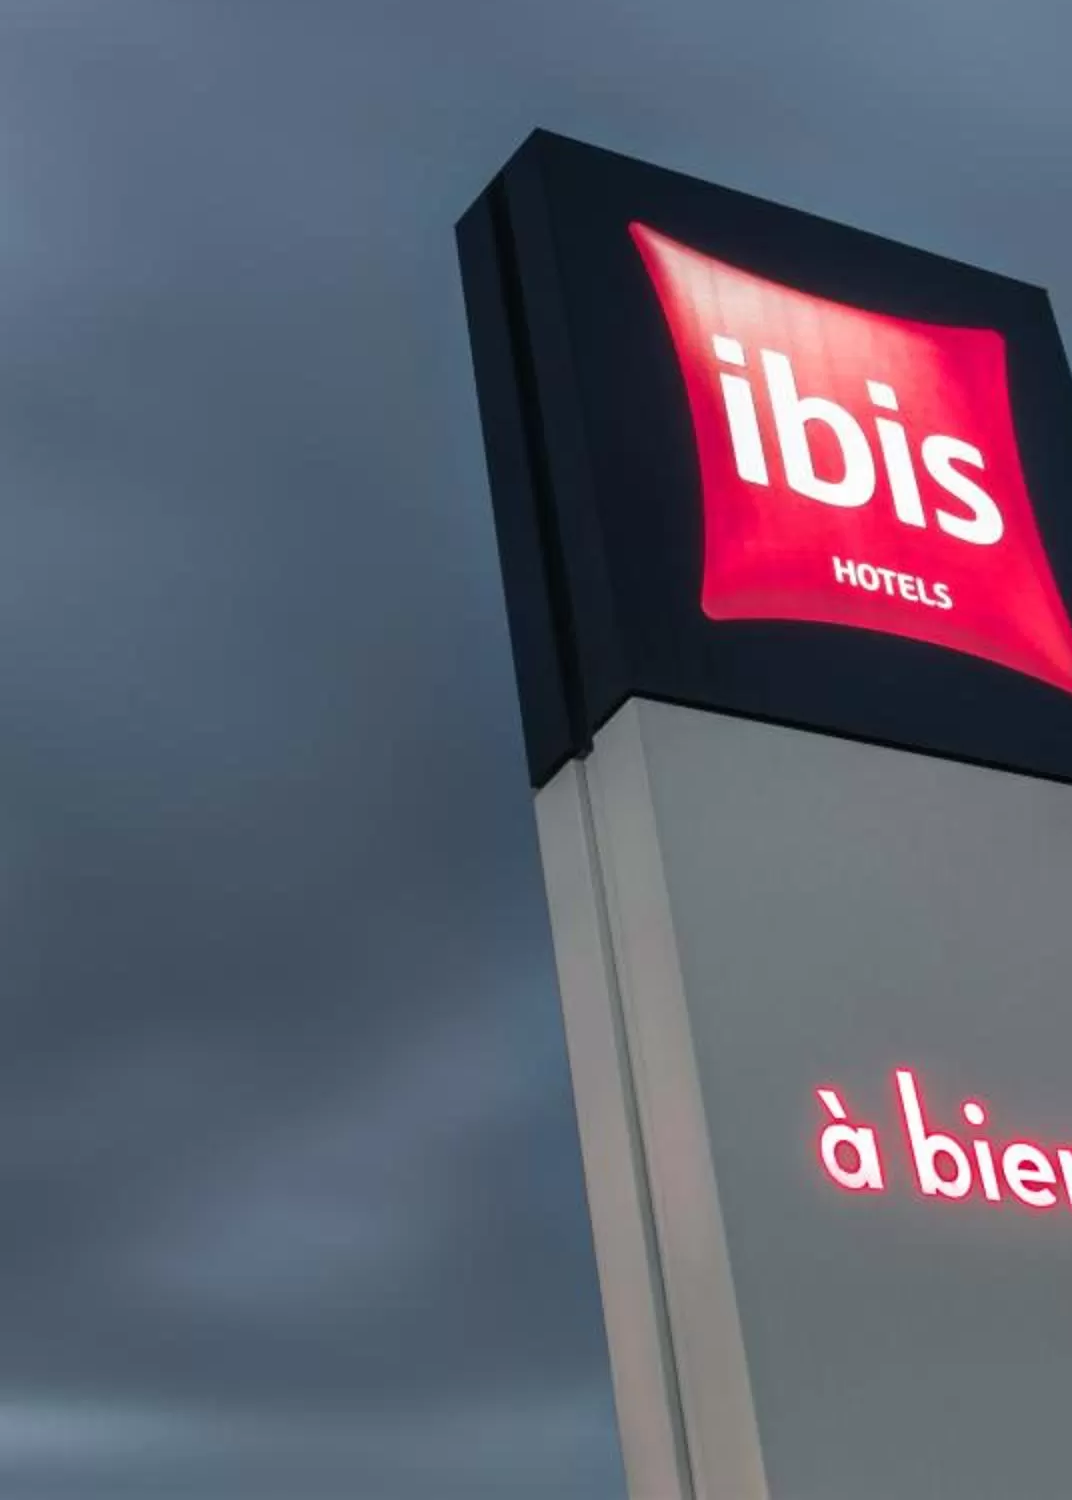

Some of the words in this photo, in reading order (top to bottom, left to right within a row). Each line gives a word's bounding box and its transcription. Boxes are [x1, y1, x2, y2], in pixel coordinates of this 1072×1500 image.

[712, 334, 1004, 545] ibis
[832, 556, 953, 610] HOTELS
[817, 1089, 884, 1190] à
